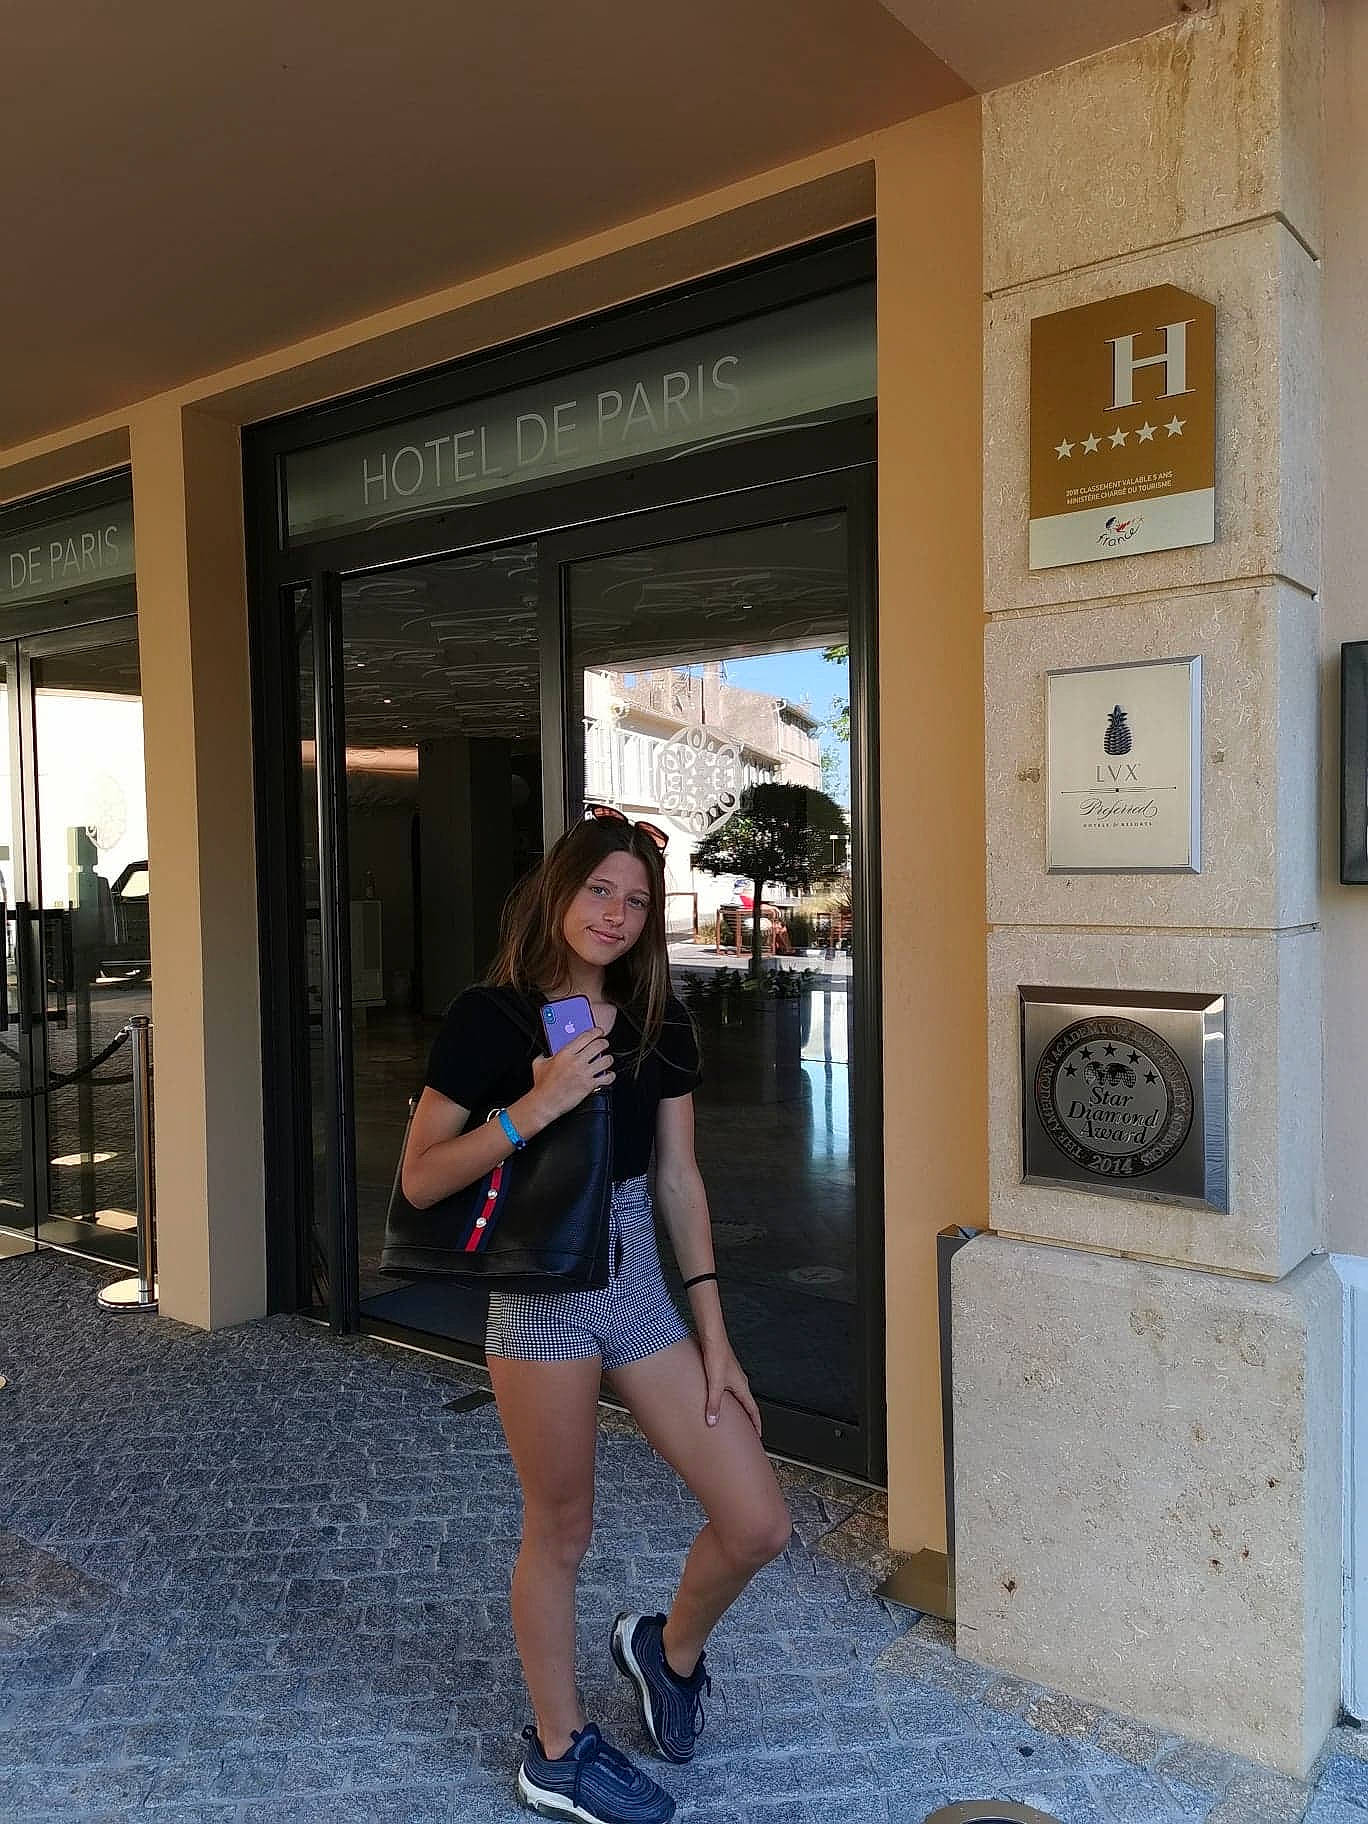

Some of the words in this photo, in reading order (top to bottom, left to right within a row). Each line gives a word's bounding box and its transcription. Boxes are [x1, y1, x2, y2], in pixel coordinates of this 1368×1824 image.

[1103, 319, 1197, 412] H
[361, 425, 503, 505] HOTEL
[515, 400, 579, 467] DE
[596, 355, 741, 442] PARIS
[1080, 480, 1121, 494] CLASSEMENT
[1122, 475, 1152, 486] VALABLE
[1159, 470, 1173, 479] ANS
[1128, 486, 1138, 494] DU
[1139, 480, 1172, 492] TOURISME
[9, 547, 42, 589] DE
[50, 525, 120, 581] PARIS
[1096, 764, 1138, 783] LVX
[1080, 798, 1158, 820] Preferred
[1092, 1086, 1134, 1107] Star
[1067, 1101, 1159, 1127] Diamond
[1080, 1120, 1148, 1144] Award
[1088, 1154, 1134, 1174] 2014
